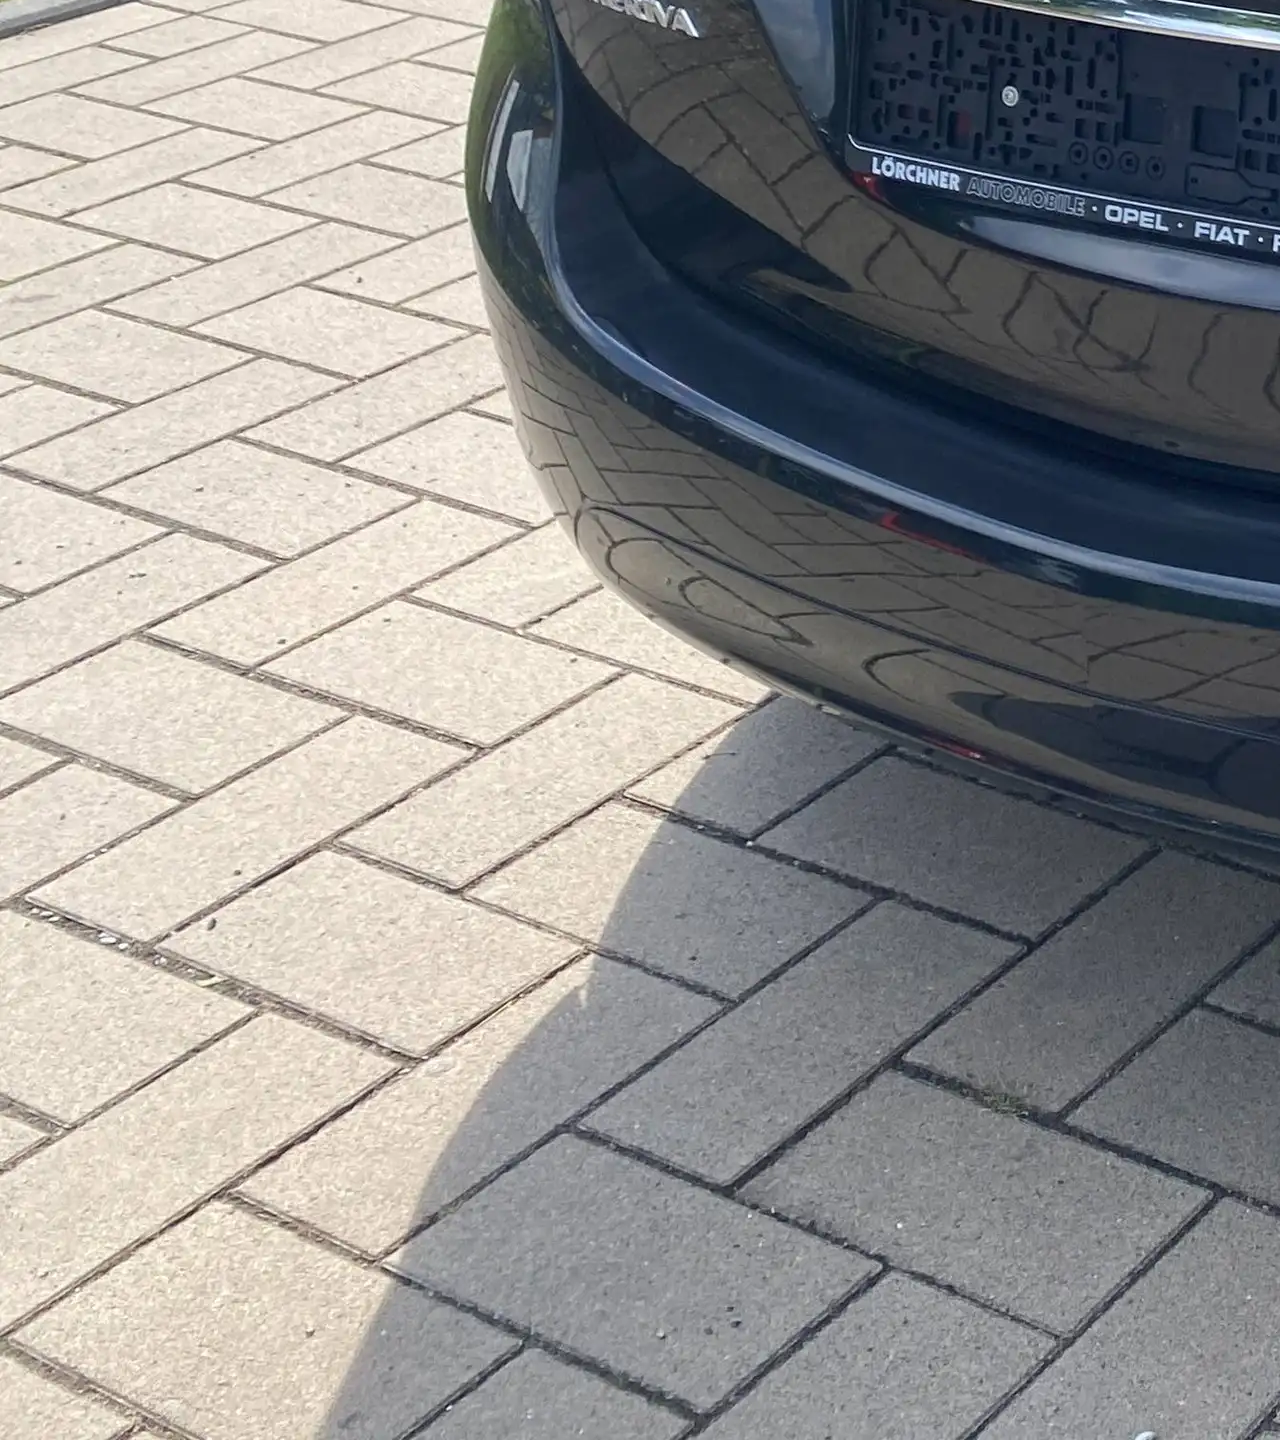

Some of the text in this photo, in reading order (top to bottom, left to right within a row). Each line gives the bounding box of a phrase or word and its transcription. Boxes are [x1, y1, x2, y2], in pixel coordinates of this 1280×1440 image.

[871, 156, 960, 192] LÖRCHNER
[966, 177, 1086, 217] AUTOMOBILE
[1104, 204, 1170, 232] OPEL
[1193, 220, 1250, 247] FIAT
